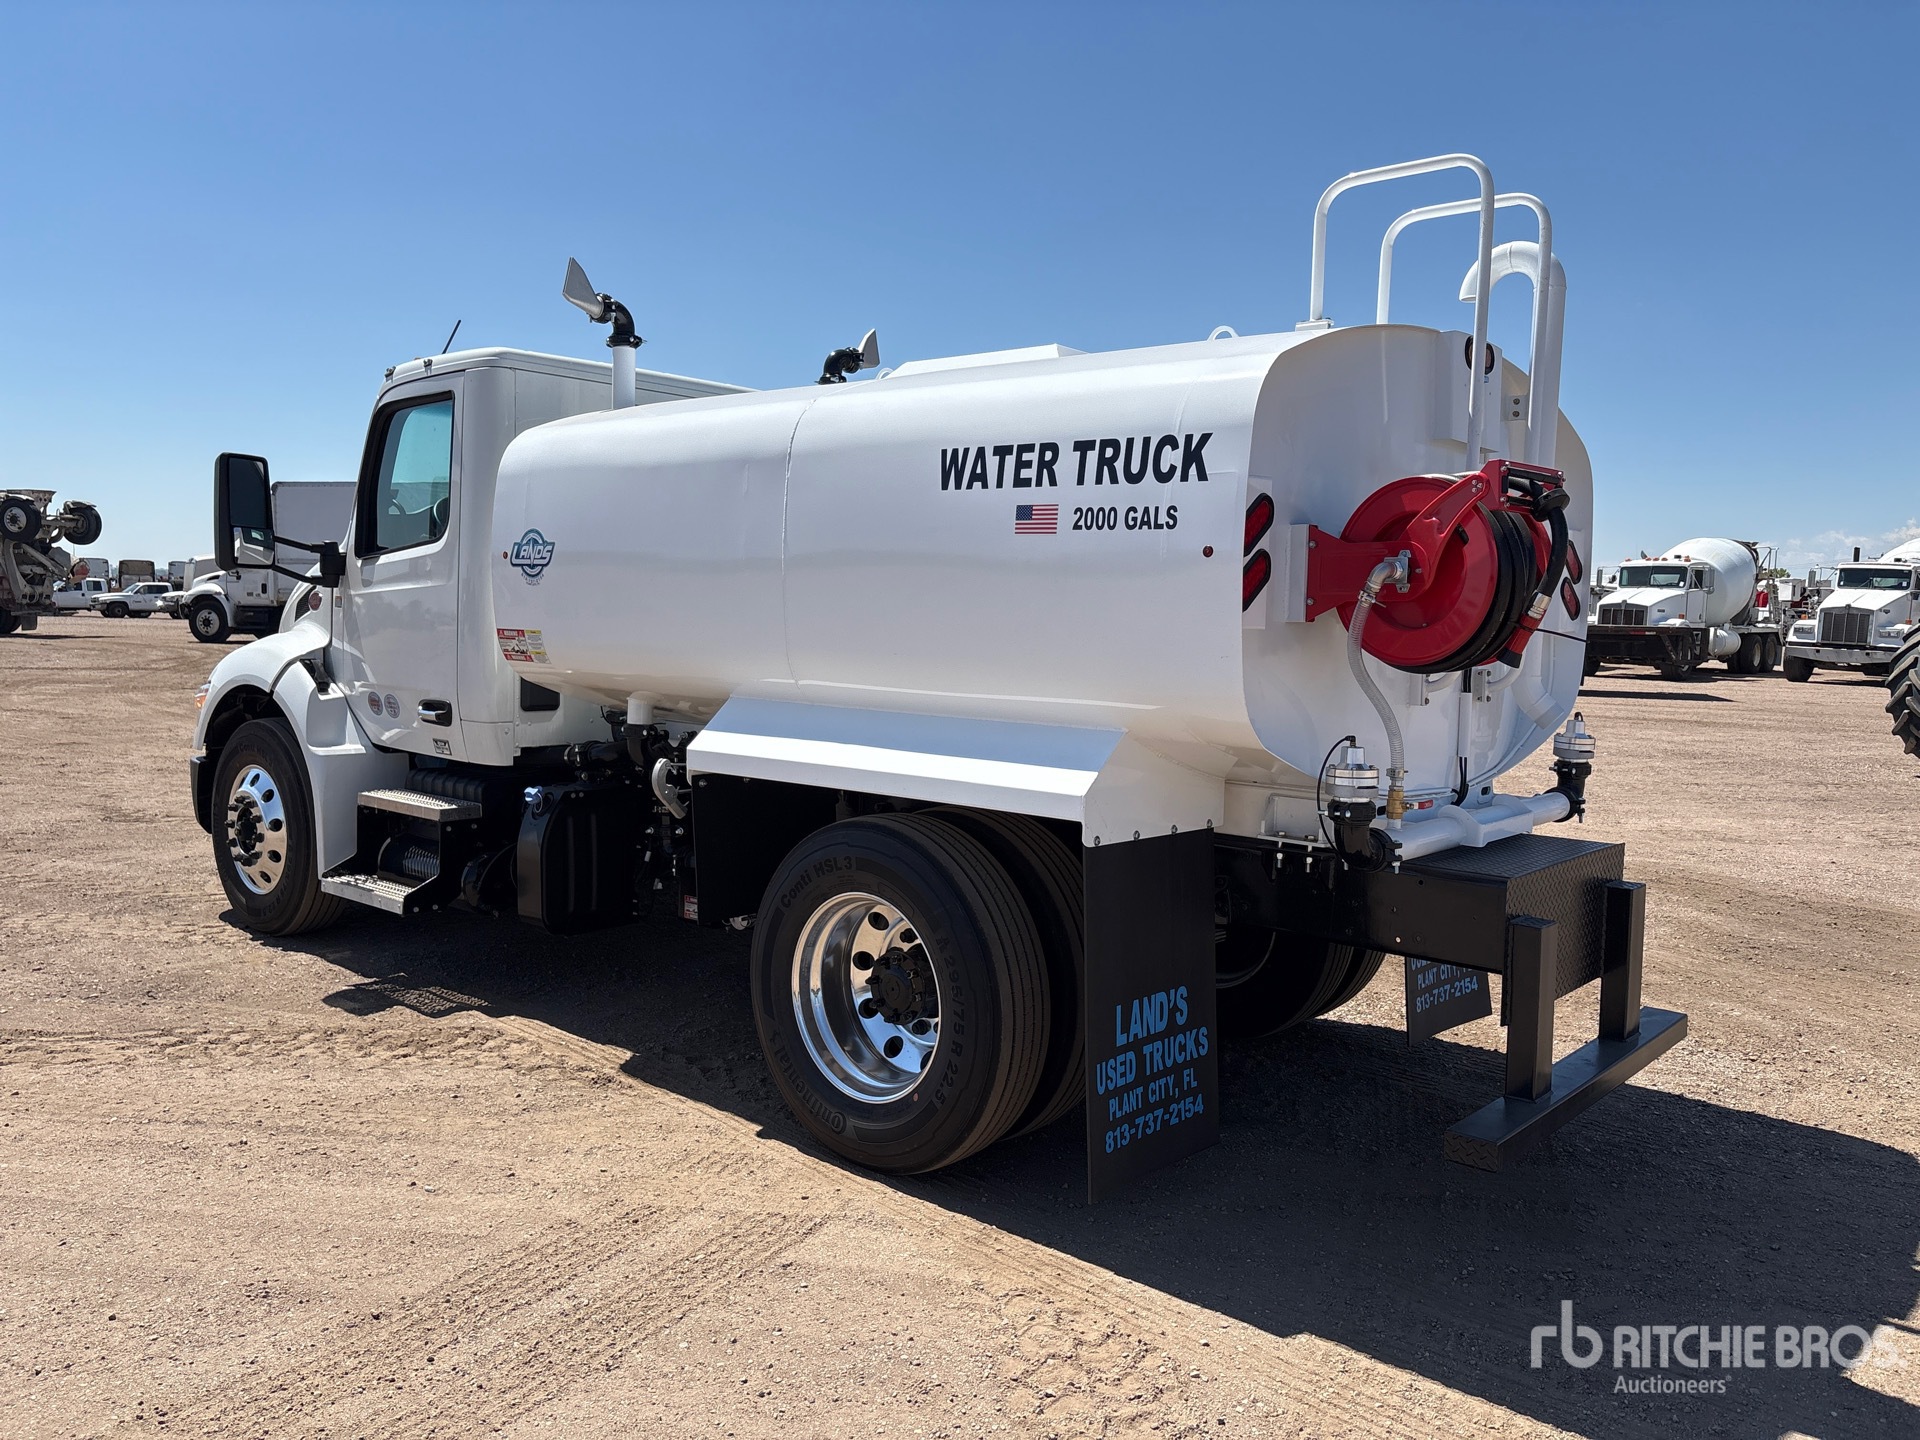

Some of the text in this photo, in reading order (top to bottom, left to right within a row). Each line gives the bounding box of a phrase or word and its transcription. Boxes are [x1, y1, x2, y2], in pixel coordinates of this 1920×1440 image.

[940, 432, 1214, 491] WATER TRUCK
[1072, 505, 1178, 531] 2000 GALS
[780, 869, 813, 908] Conti
[1416, 975, 1479, 1013] 813-737-2154
[1417, 967, 1438, 990] PLANT
[1116, 985, 1189, 1047] LAND'S
[1095, 1026, 1209, 1095] USED TRUCKS
[1109, 1067, 1198, 1122] PLANT CITY, FL
[1105, 1093, 1204, 1154] 813-737-2154
